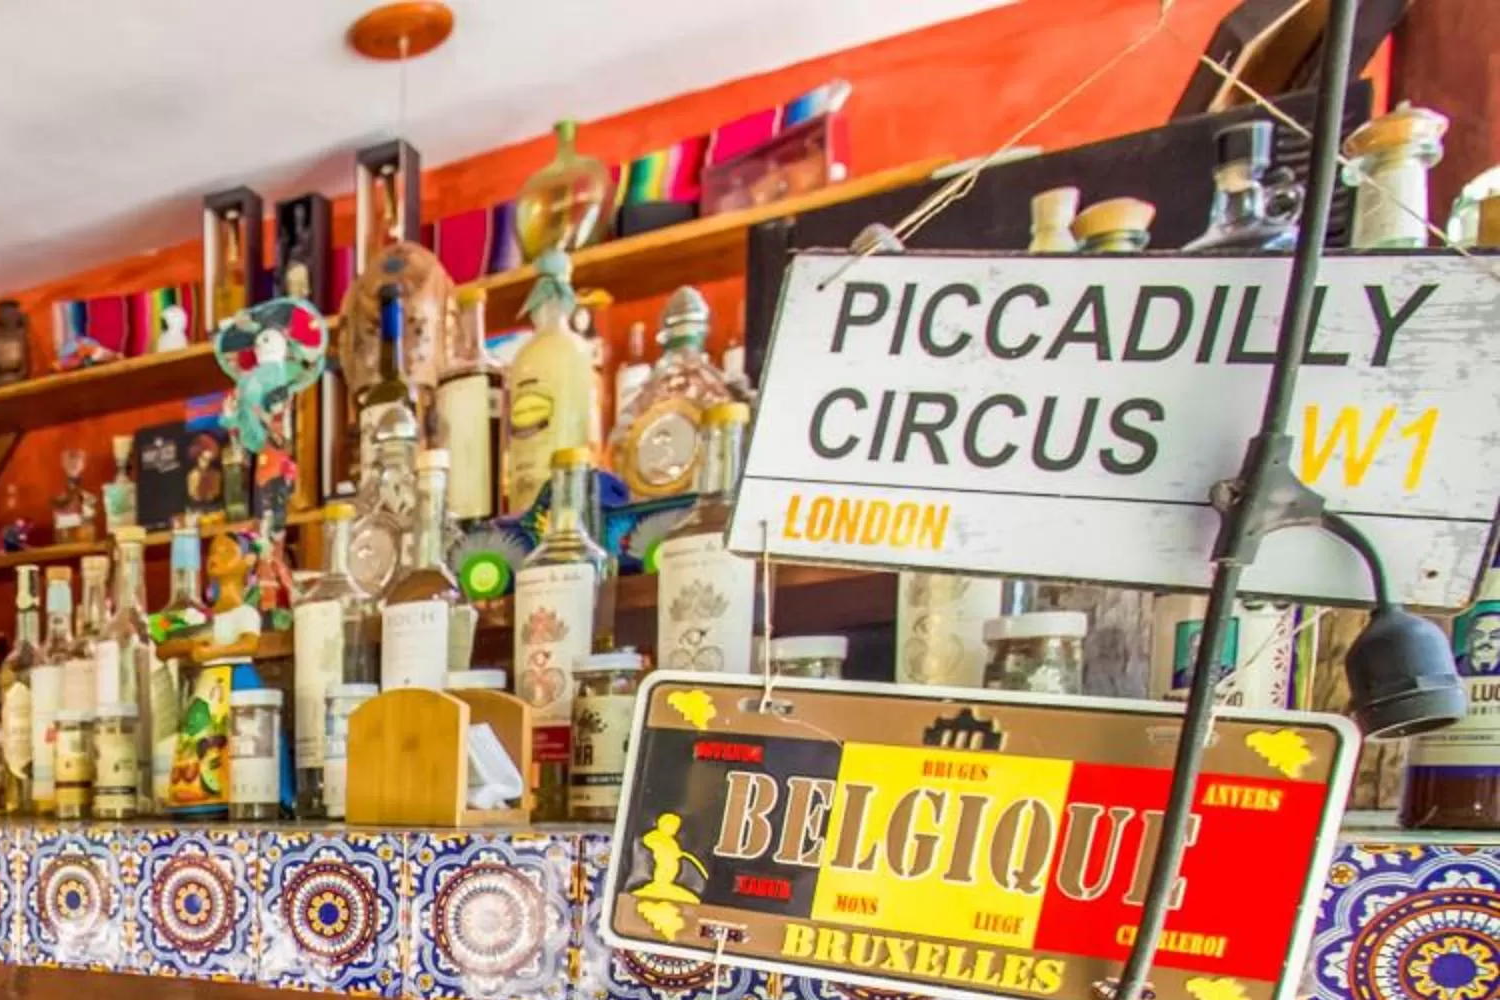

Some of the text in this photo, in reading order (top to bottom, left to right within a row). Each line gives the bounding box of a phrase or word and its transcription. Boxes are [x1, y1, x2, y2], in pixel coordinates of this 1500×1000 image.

[828, 281, 1442, 368] PICCADILLY
[808, 386, 1165, 476] CIRCUS
[1299, 403, 1440, 493] W1
[781, 494, 951, 552] LONDON
[922, 760, 990, 782] BRUGES
[1201, 784, 1284, 812] ANVERS
[713, 770, 1202, 911] BELGIQUE
[833, 893, 879, 916] MONS
[780, 922, 1066, 996] BRUXELLES
[1114, 923, 1228, 959] CRLEROI
